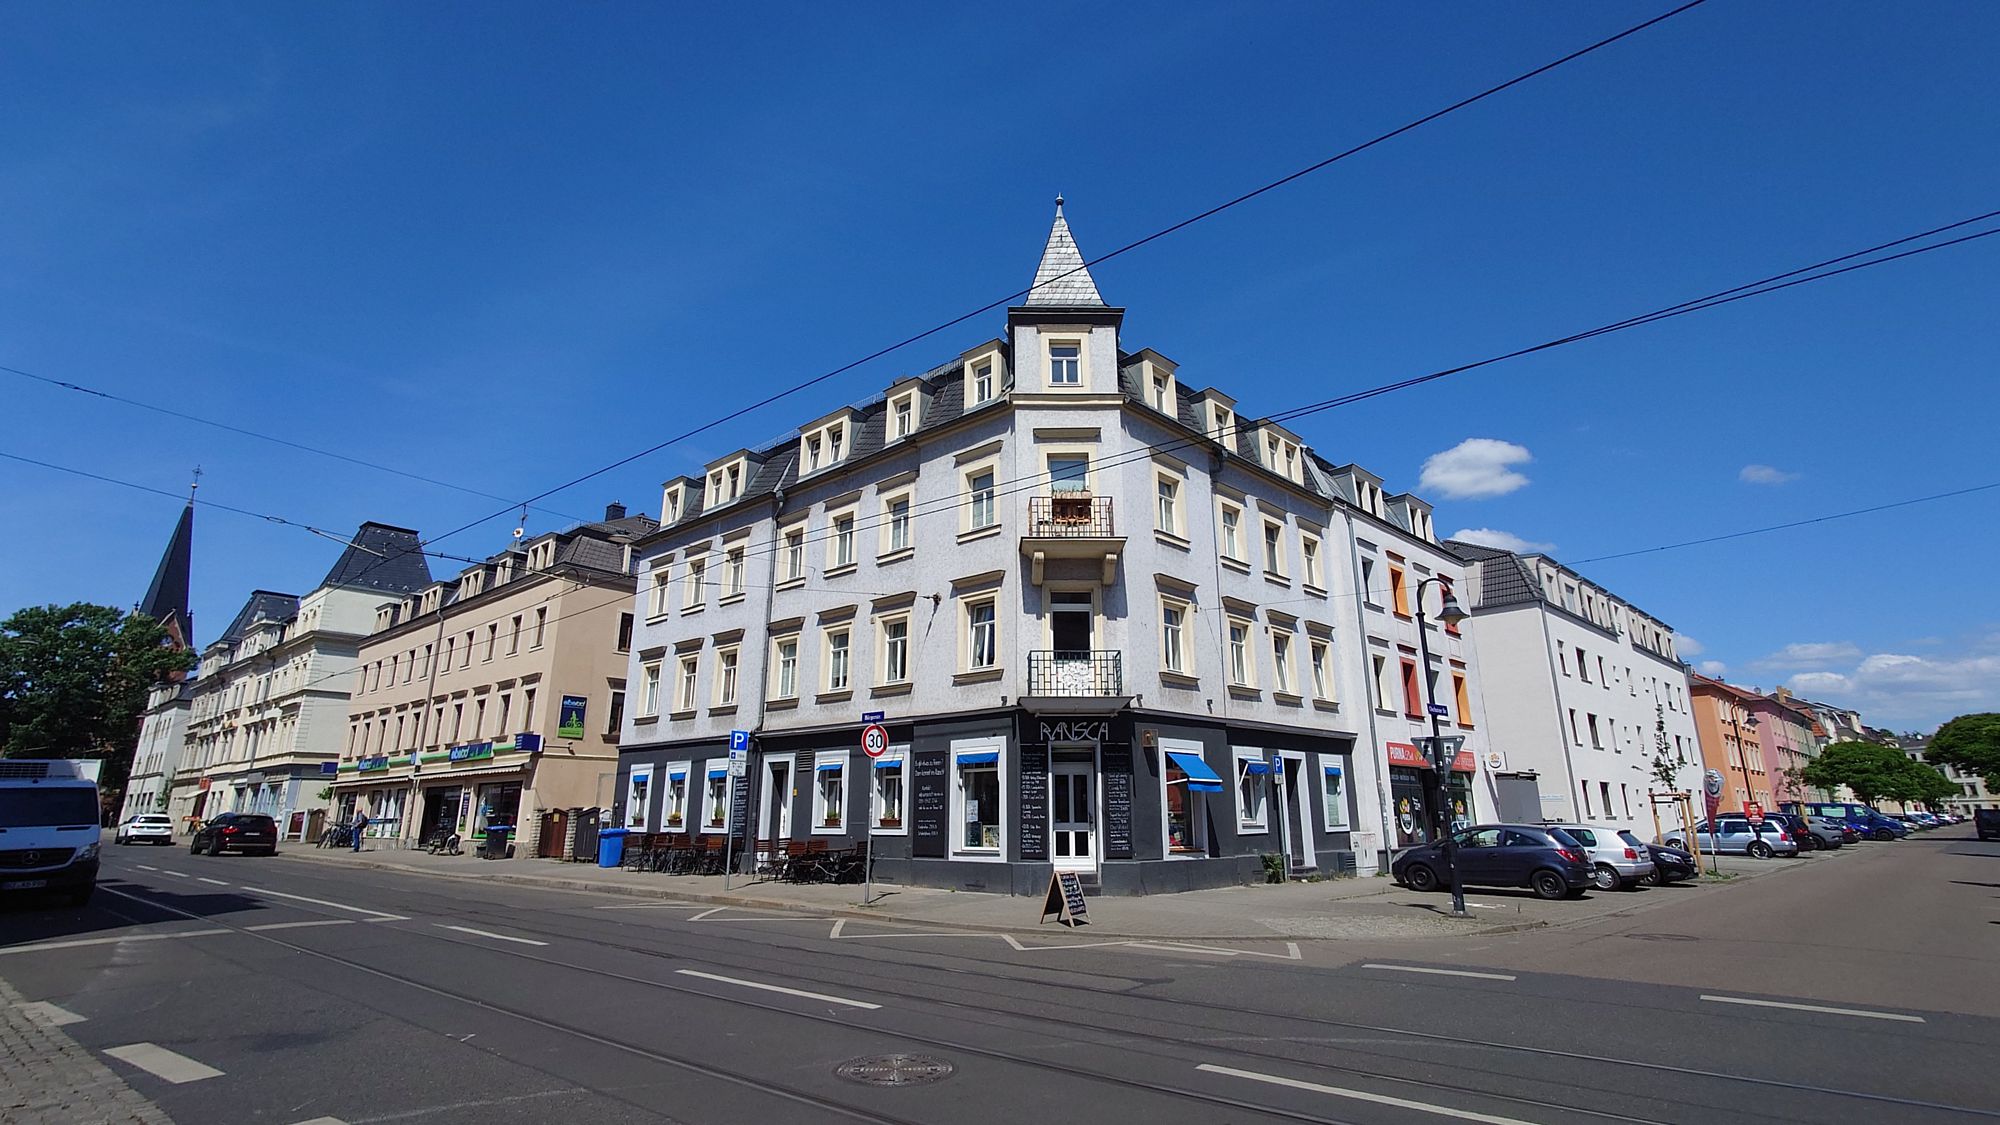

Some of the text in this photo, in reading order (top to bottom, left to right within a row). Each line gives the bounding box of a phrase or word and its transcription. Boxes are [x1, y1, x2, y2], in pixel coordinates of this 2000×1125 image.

[733, 732, 745, 749] P
[867, 733, 884, 749] 30
[1274, 757, 1281, 772] P
